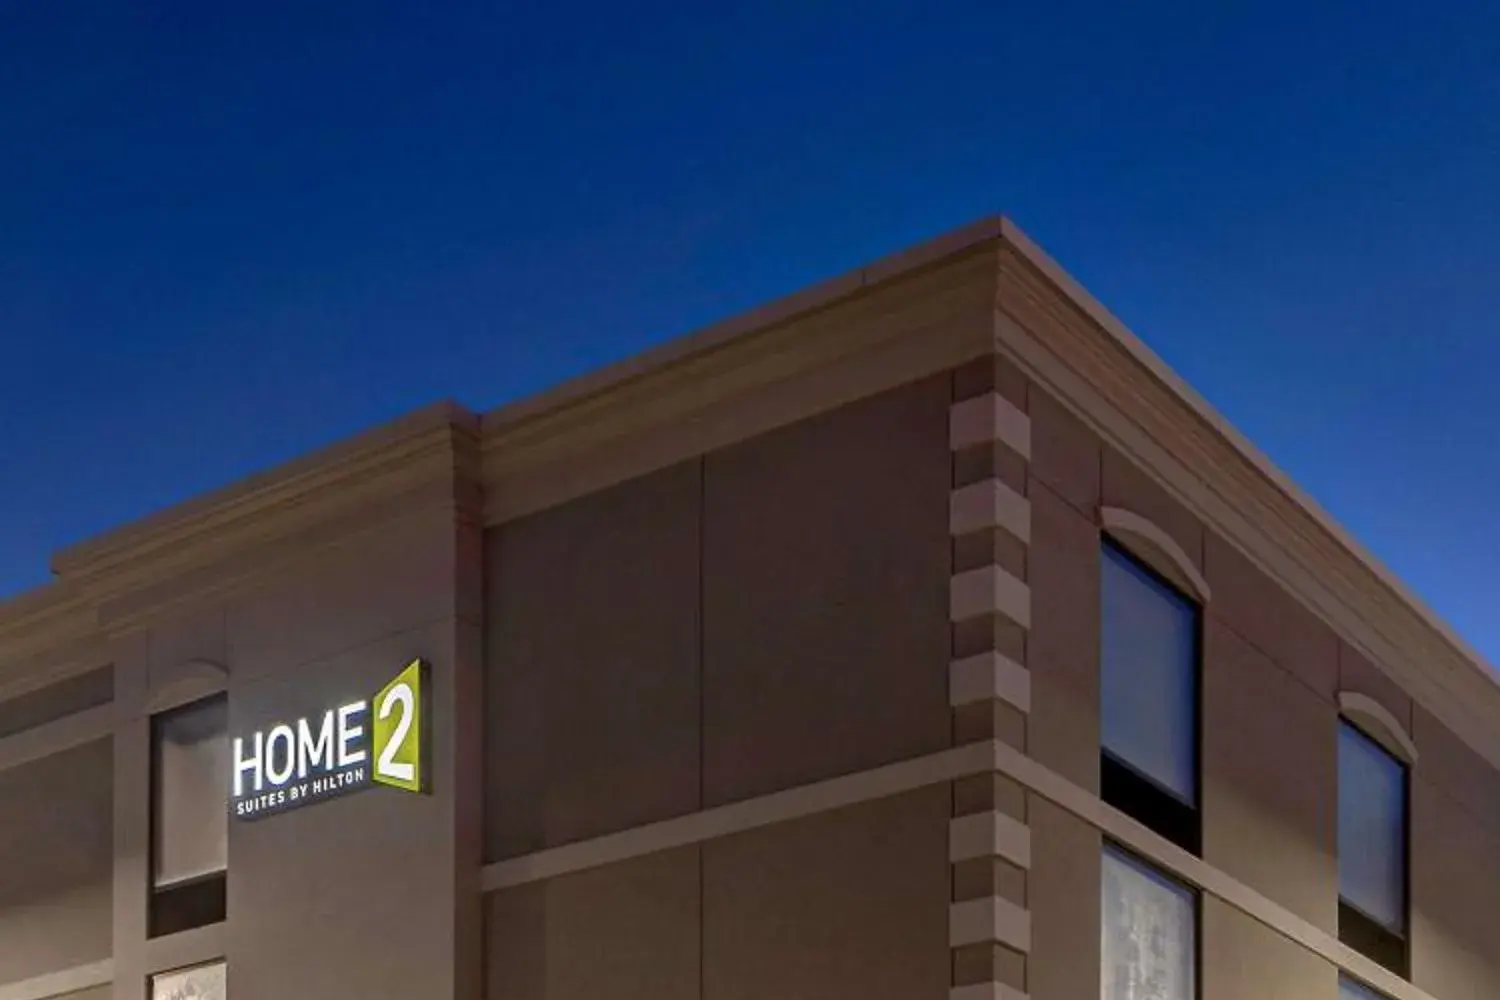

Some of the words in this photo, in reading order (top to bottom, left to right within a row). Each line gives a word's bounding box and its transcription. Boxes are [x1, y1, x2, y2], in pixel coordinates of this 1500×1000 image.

[233, 701, 367, 796] HOME
[379, 684, 414, 780] 2
[236, 789, 285, 816] SUITES
[290, 783, 308, 800] BY
[312, 768, 365, 793] HILTON
